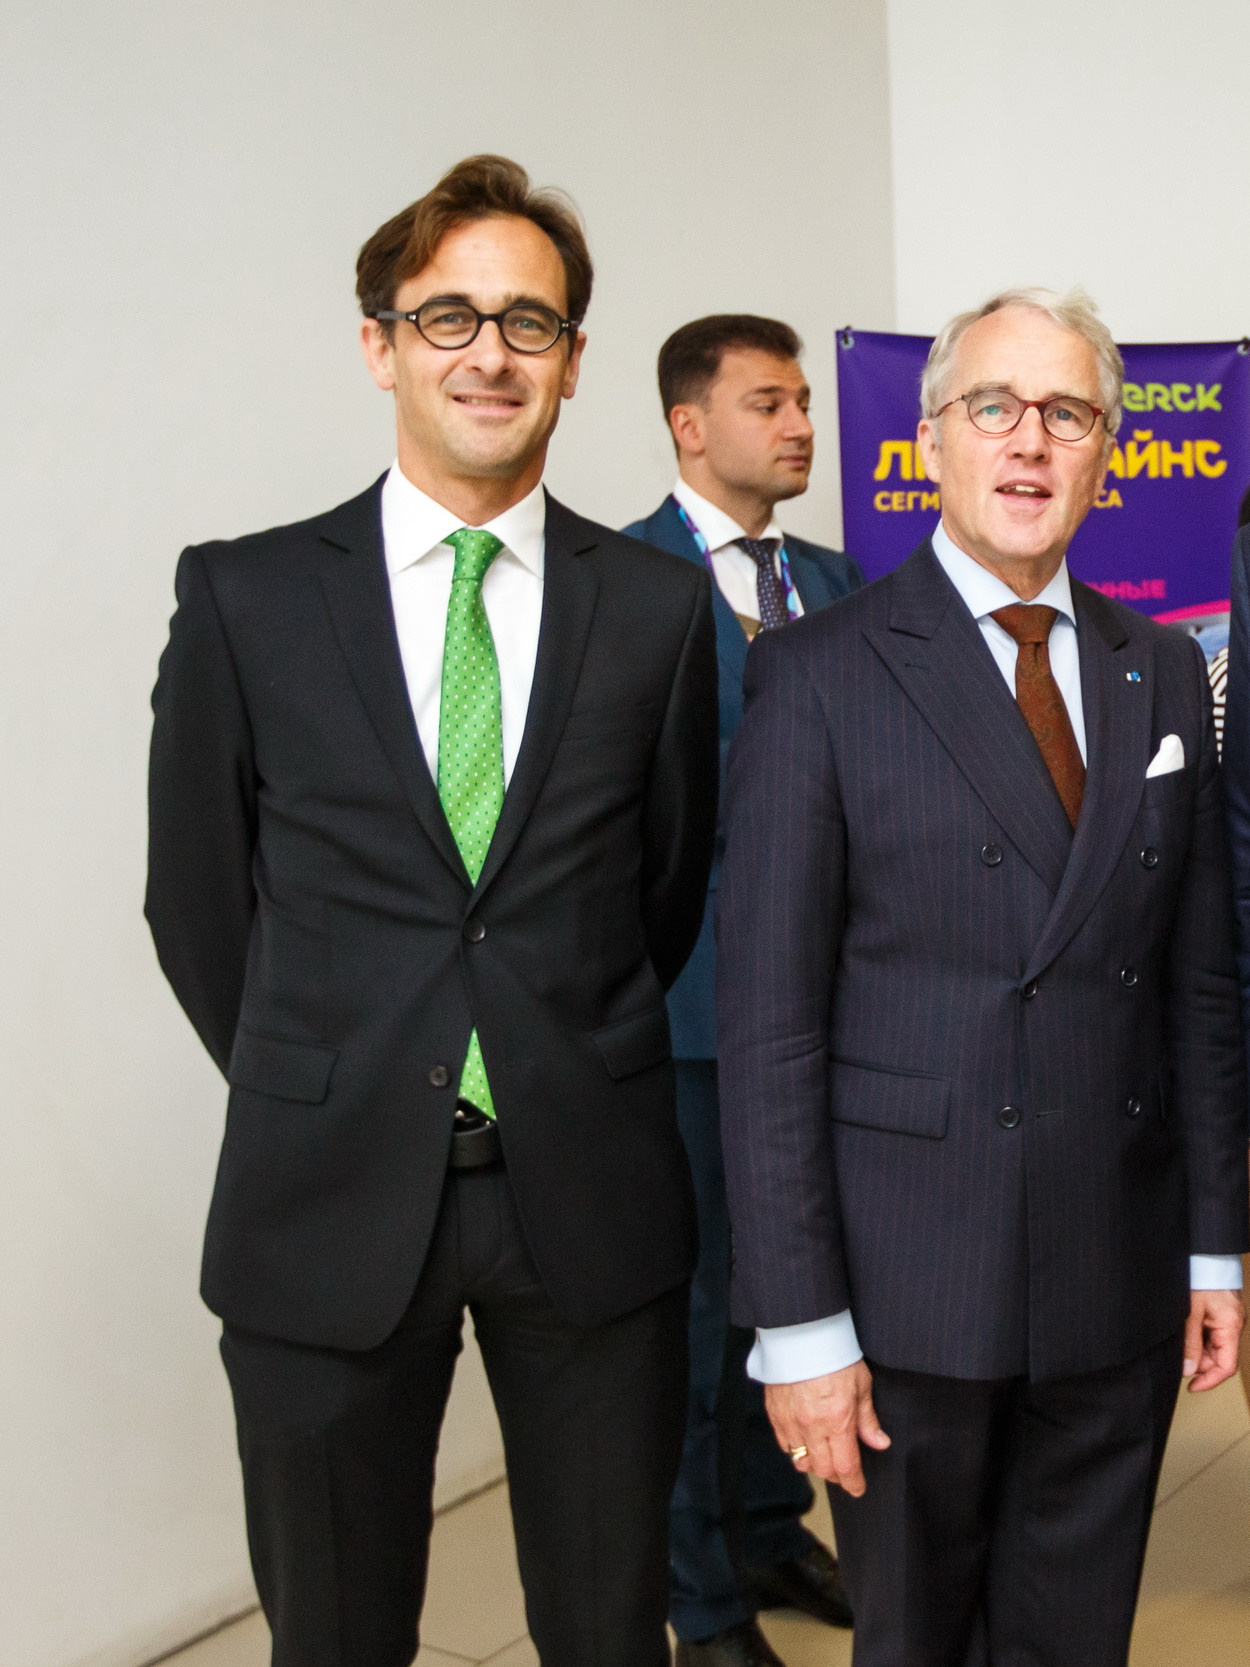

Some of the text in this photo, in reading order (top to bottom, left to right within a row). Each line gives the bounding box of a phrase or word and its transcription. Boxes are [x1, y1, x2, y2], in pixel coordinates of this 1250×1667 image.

[1121, 383, 1222, 411] ERCK
[1108, 428, 1227, 479] АЙНС
[873, 490, 941, 512] СЕГМ
